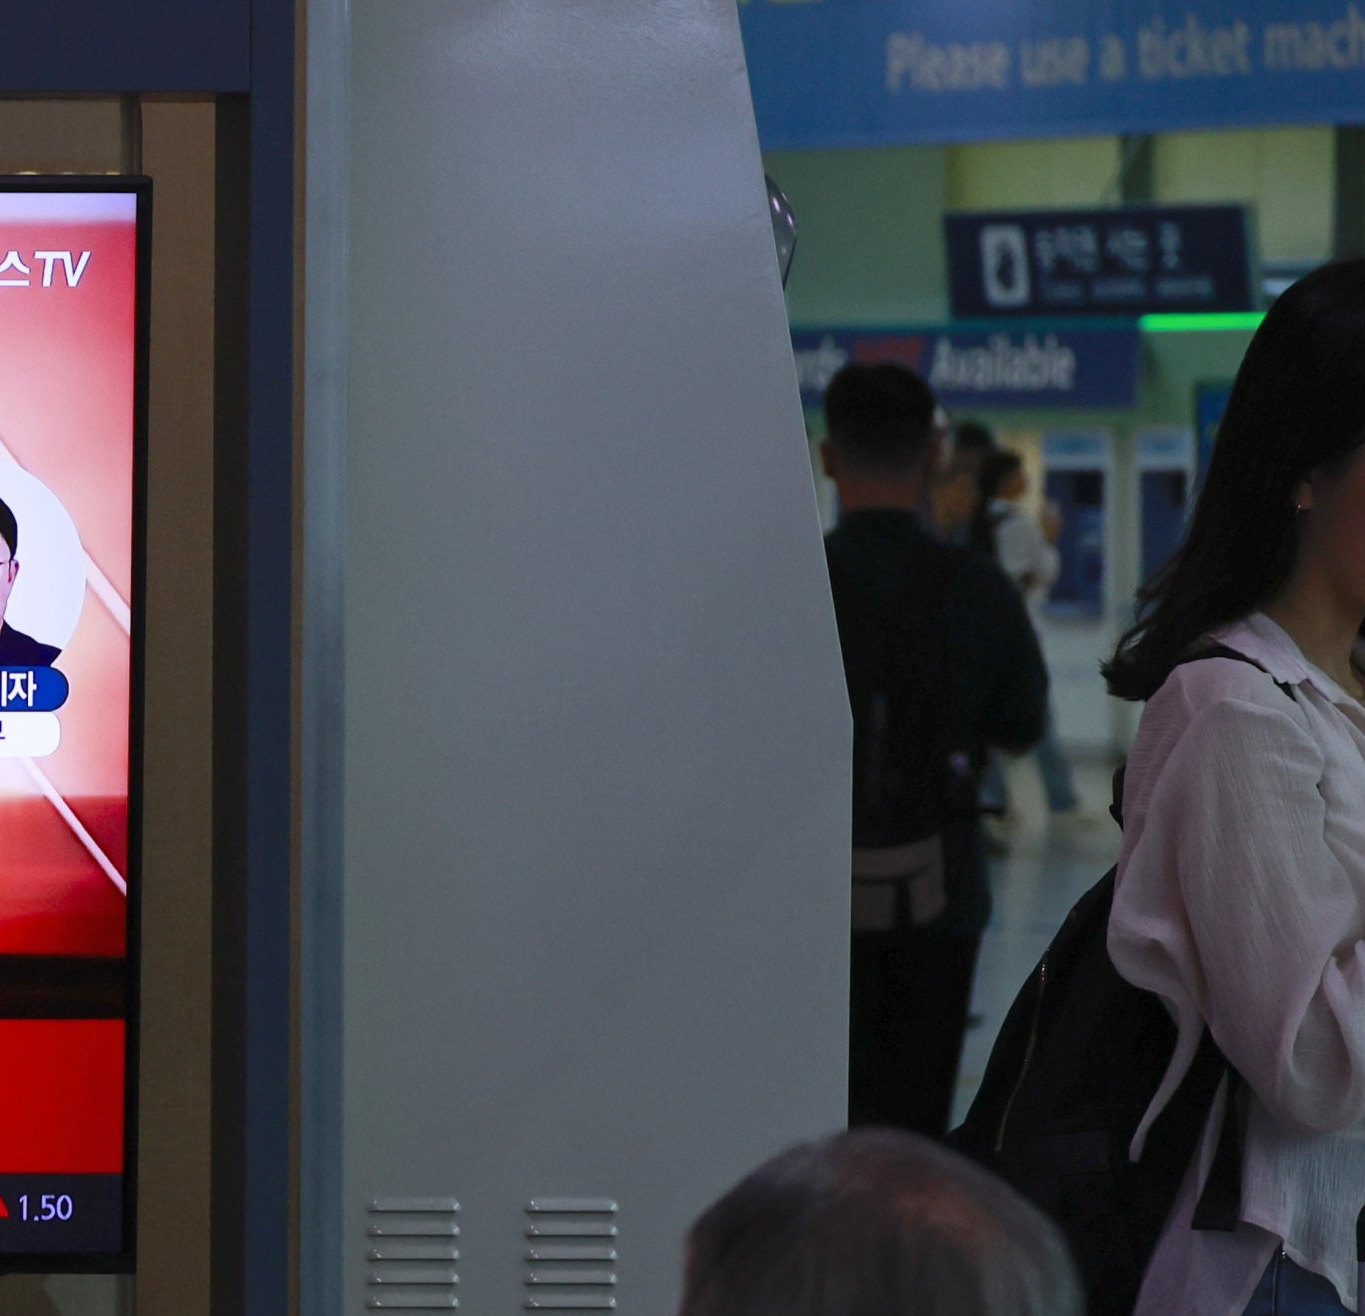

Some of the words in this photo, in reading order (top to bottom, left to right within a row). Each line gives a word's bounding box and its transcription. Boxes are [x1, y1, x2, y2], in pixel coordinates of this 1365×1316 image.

[885, 28, 1012, 96] Please
[1019, 33, 1089, 87] use
[1099, 40, 1126, 82] a
[1138, 20, 1254, 80] ticket
[931, 333, 1076, 391] Available
[20, 1196, 72, 1220] 1.50
